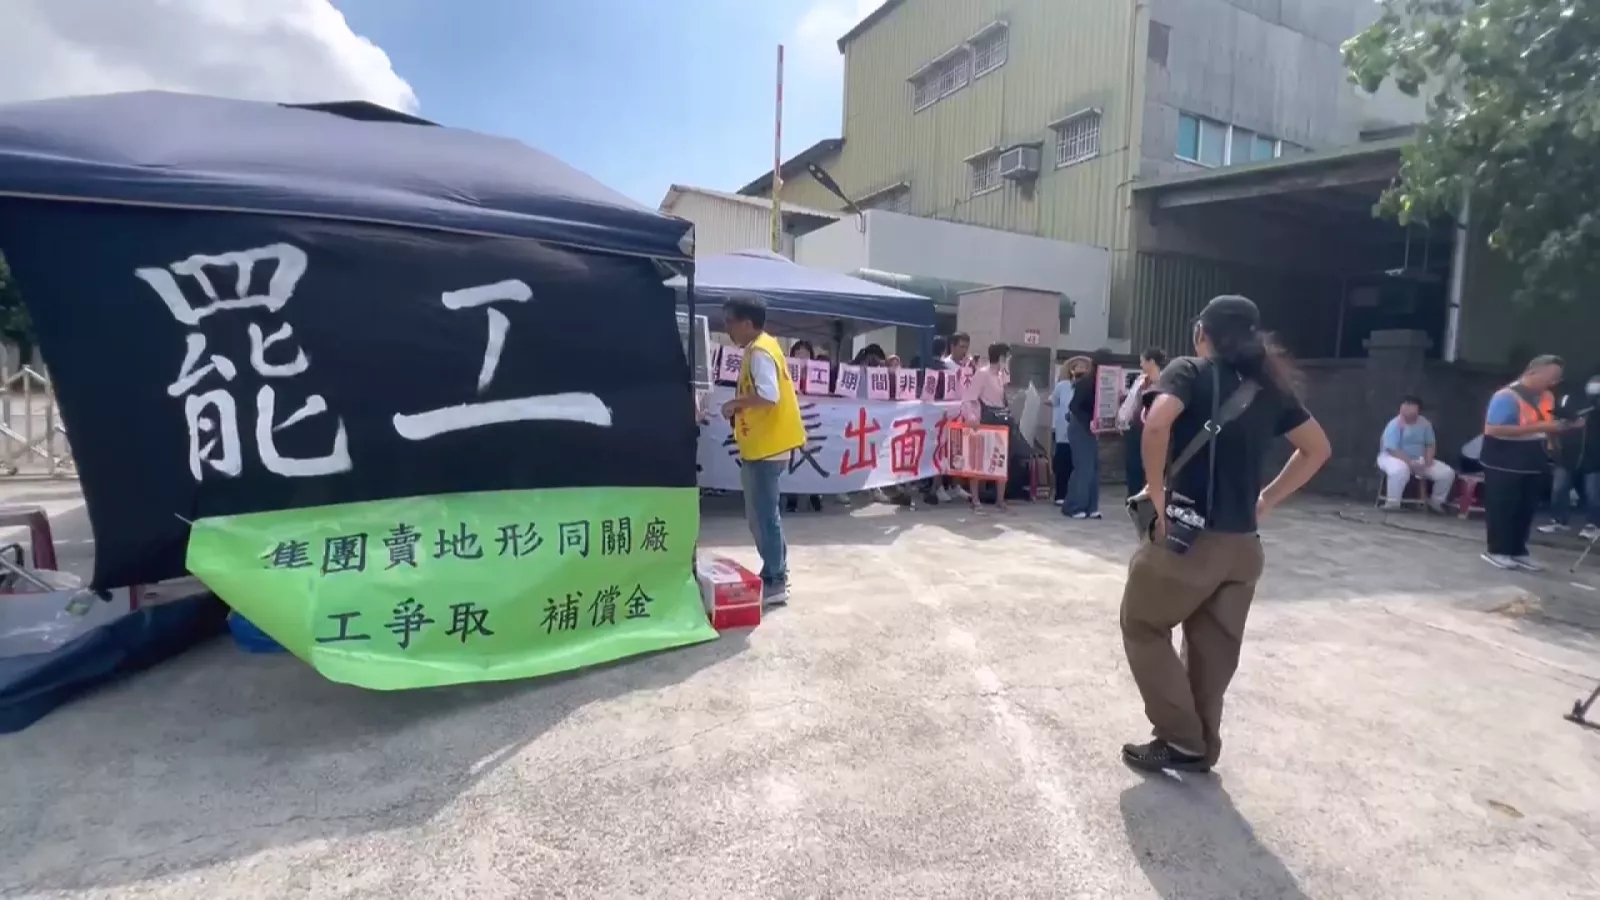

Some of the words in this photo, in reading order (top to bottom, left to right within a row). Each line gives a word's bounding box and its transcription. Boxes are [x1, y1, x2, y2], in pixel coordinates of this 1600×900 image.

[136, 243, 612, 480] 罷工
[261, 516, 670, 577] 集團賣地形同關廠
[315, 597, 495, 650] 工爭取
[540, 583, 655, 635] 補償金
